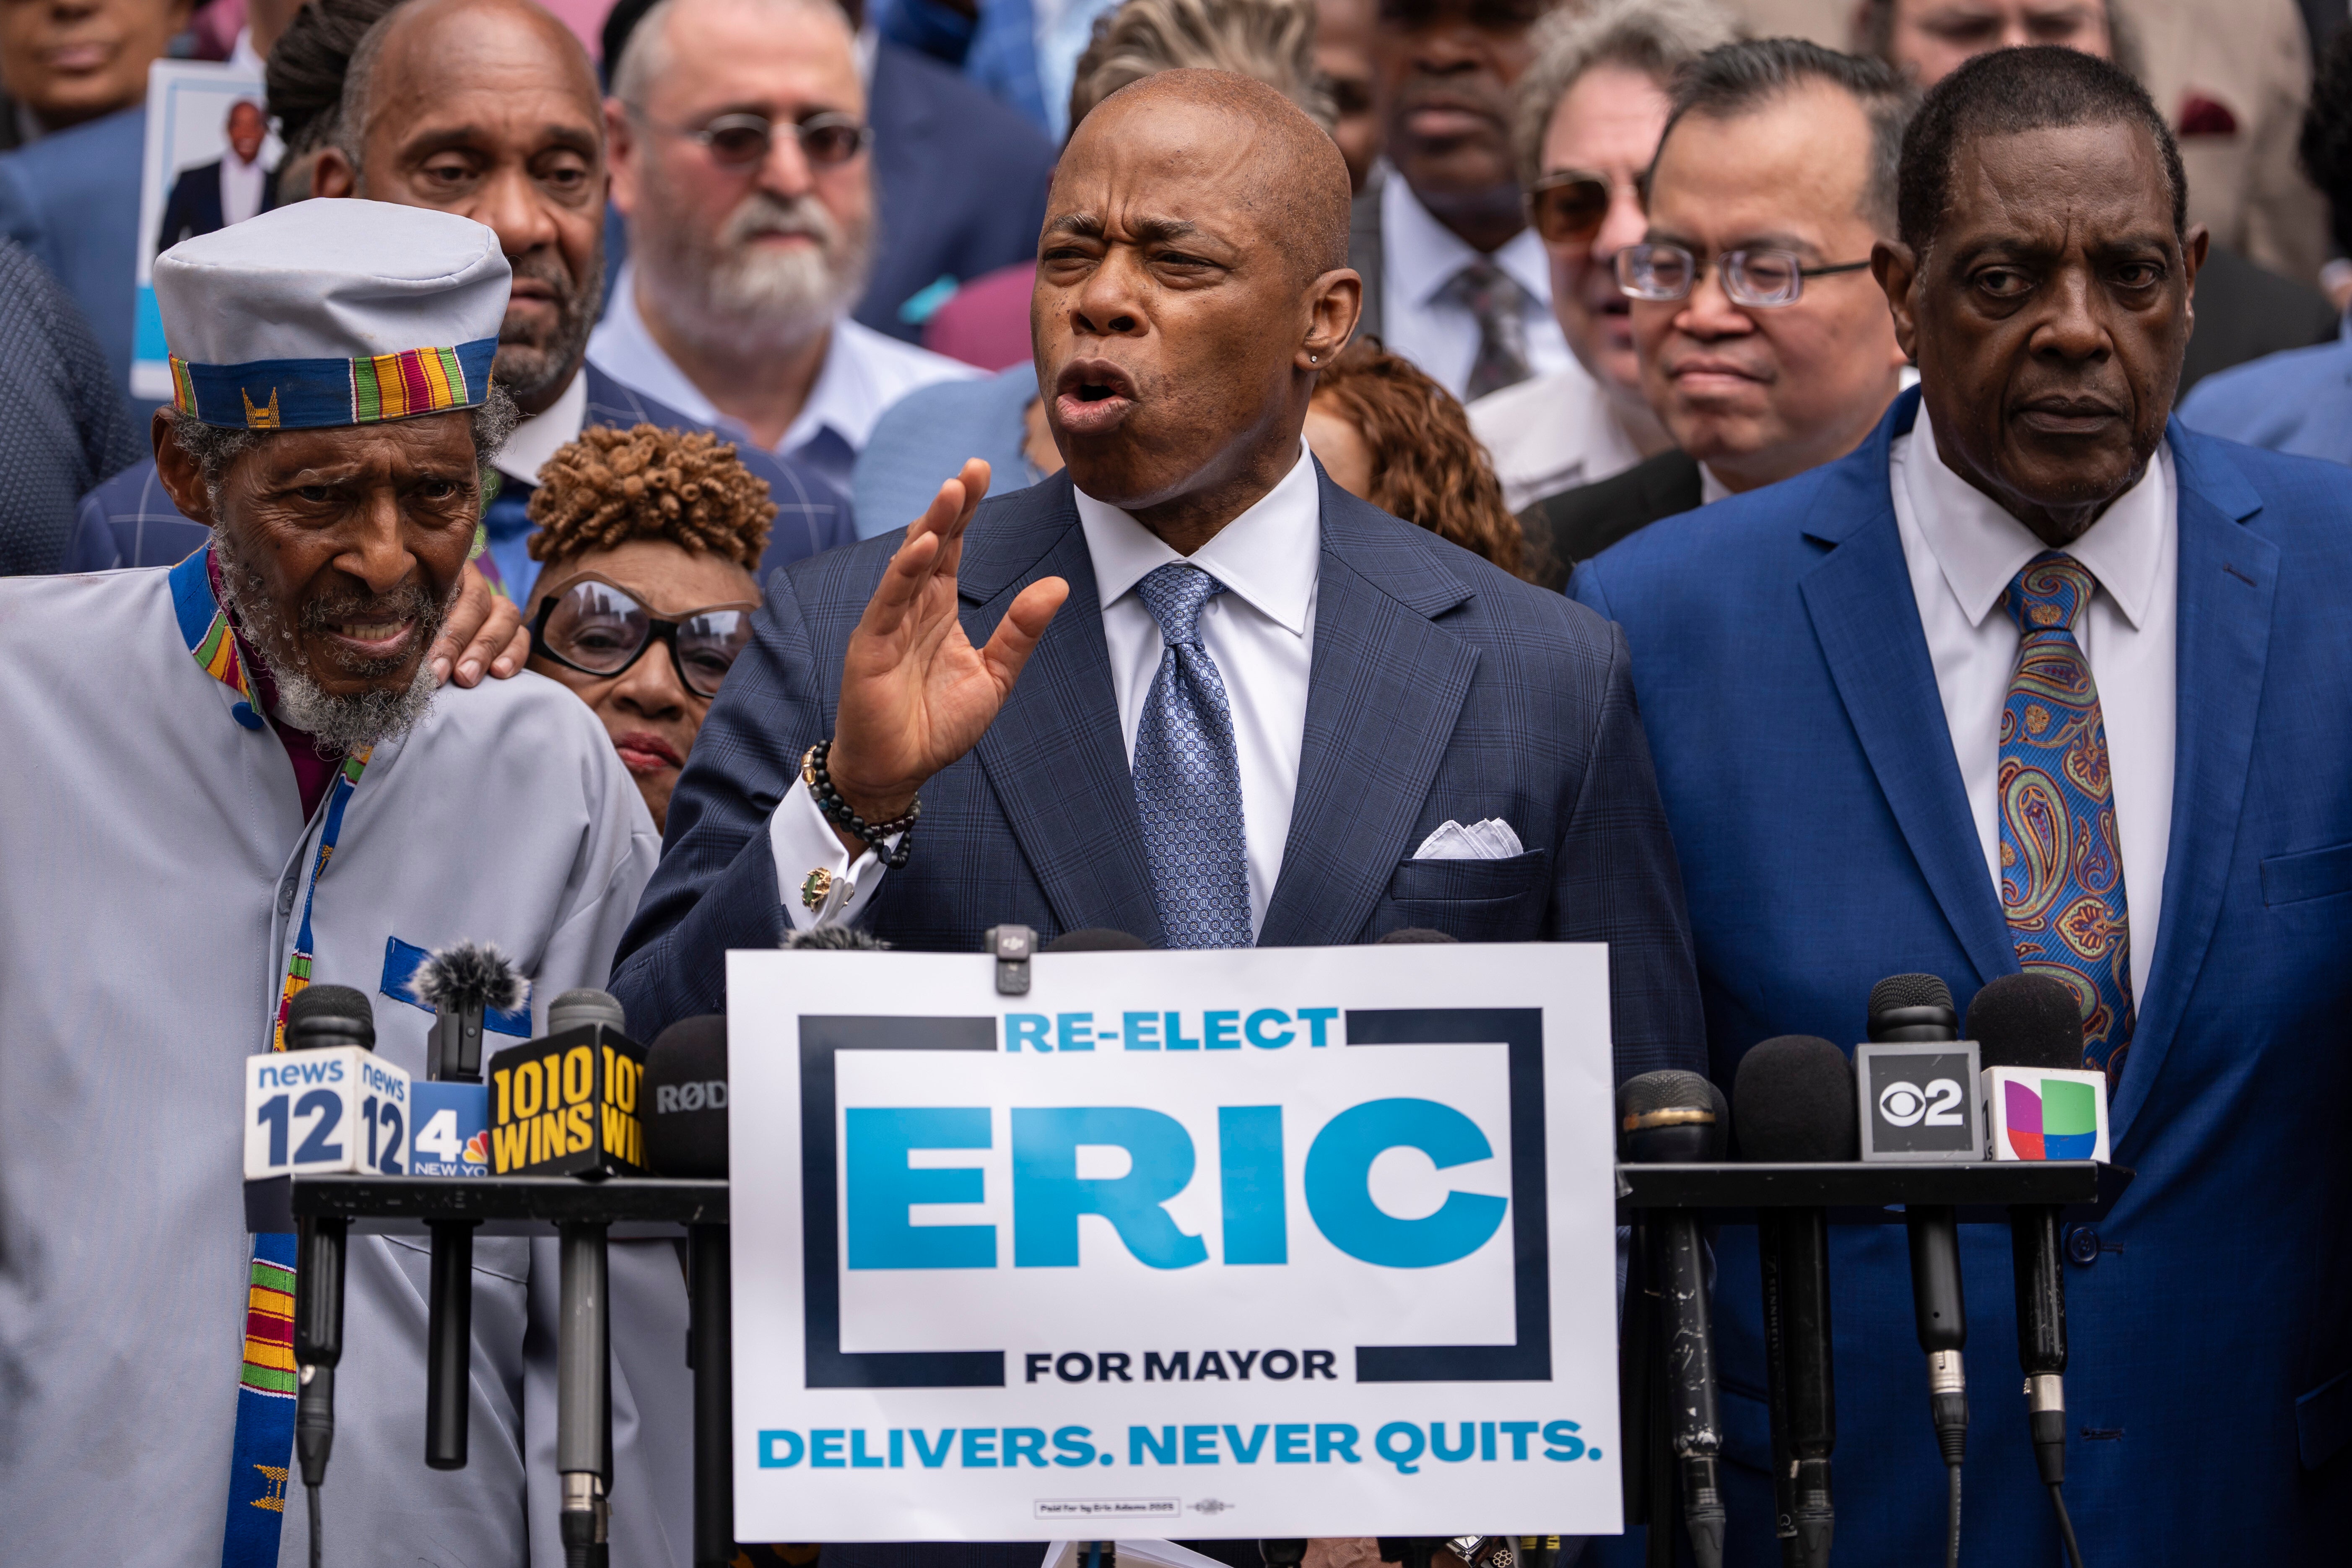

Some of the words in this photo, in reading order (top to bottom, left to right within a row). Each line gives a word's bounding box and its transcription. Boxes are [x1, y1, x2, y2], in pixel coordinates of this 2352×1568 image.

[1005, 1007, 1339, 1054] RE-ELECT
[259, 1060, 344, 1089] news
[363, 1063, 404, 1102] news
[493, 1045, 594, 1126] 1010
[257, 1088, 343, 1167] 12
[363, 1094, 403, 1174] 12
[415, 1109, 463, 1162] 4
[492, 1101, 594, 1175] WINS
[415, 1161, 457, 1176] NEW
[845, 1097, 1509, 1271] ERIC
[1025, 1352, 1133, 1383] FOR
[1144, 1349, 1337, 1381] MAYOR
[758, 1425, 1114, 1469] DELIVERS.
[1128, 1423, 1362, 1466] NEVER
[1374, 1419, 1603, 1475] QUITS.
